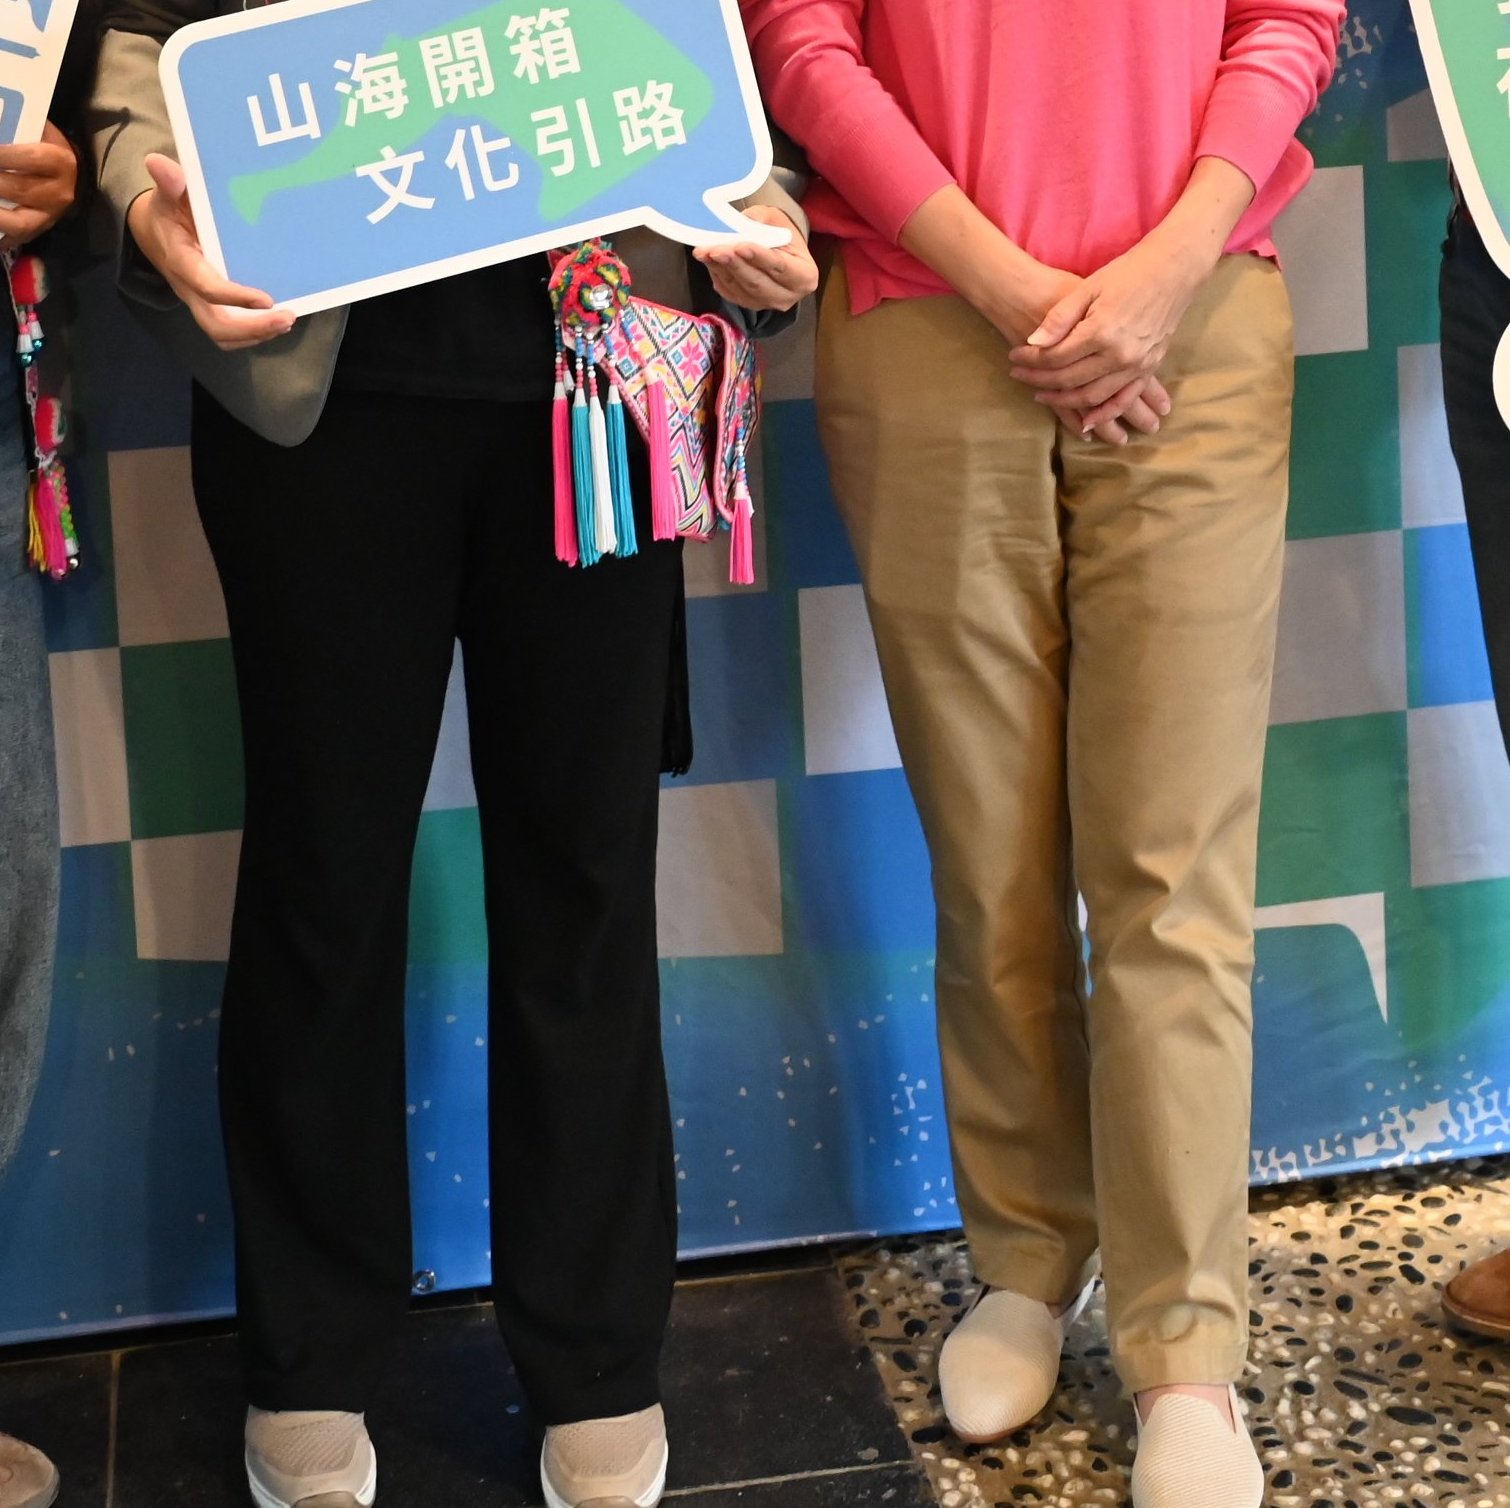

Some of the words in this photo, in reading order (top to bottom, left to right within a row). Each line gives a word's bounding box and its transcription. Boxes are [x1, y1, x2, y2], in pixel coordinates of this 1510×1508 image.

[246, 7, 582, 148] 山海開箱
[355, 79, 688, 226] 文化引路
